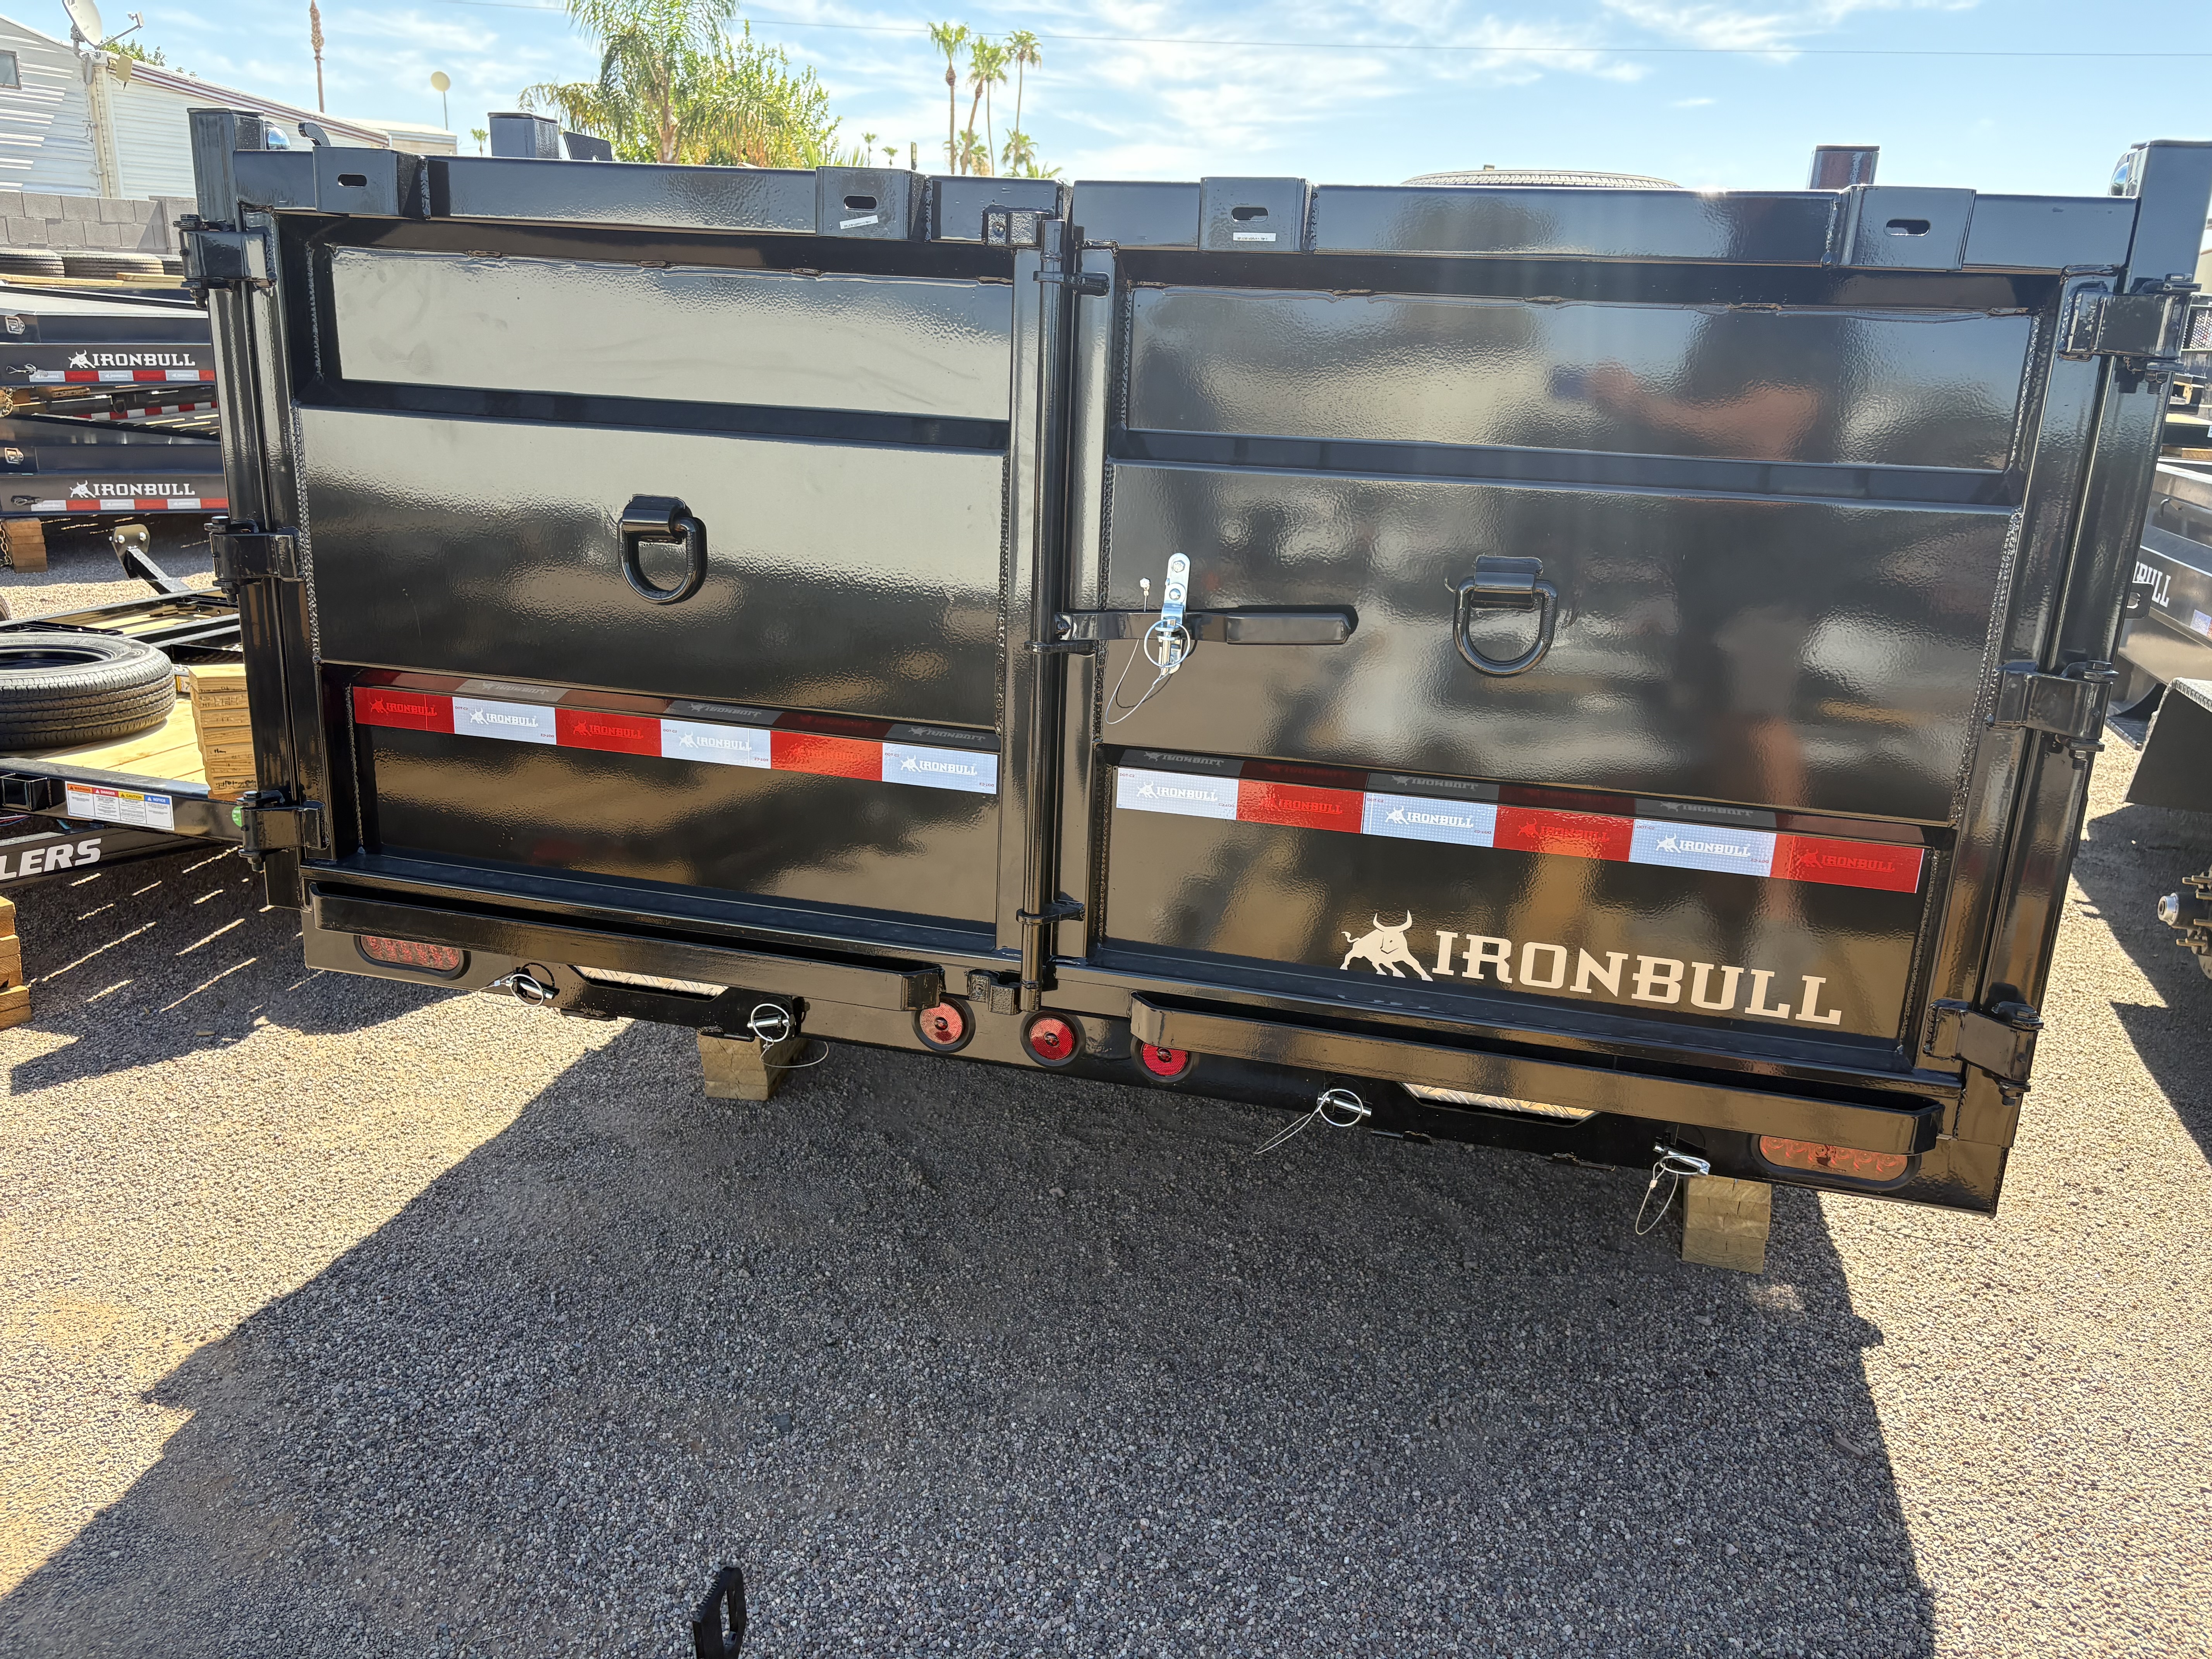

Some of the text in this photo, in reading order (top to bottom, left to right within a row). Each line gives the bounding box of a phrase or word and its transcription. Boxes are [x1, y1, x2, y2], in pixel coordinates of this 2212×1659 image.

[92, 354, 196, 366] IRONBULL
[93, 483, 195, 495] IRONBULL
[386, 702, 437, 715] IRONBULL
[486, 713, 538, 727] IRONBULL
[589, 725, 644, 739] IRONBULL
[697, 737, 752, 750] IRONBULL
[919, 761, 977, 775] IRONBULL
[1157, 787, 1218, 801] IRONBULL
[1279, 799, 1343, 814] IRONBULL
[1407, 812, 1474, 828] IRONBULL
[1679, 840, 1750, 857] IRONBULL
[0, 838, 101, 880] LERS
[1822, 855, 1895, 872] IRONBULL
[1432, 929, 1842, 1025] IRONBULL
